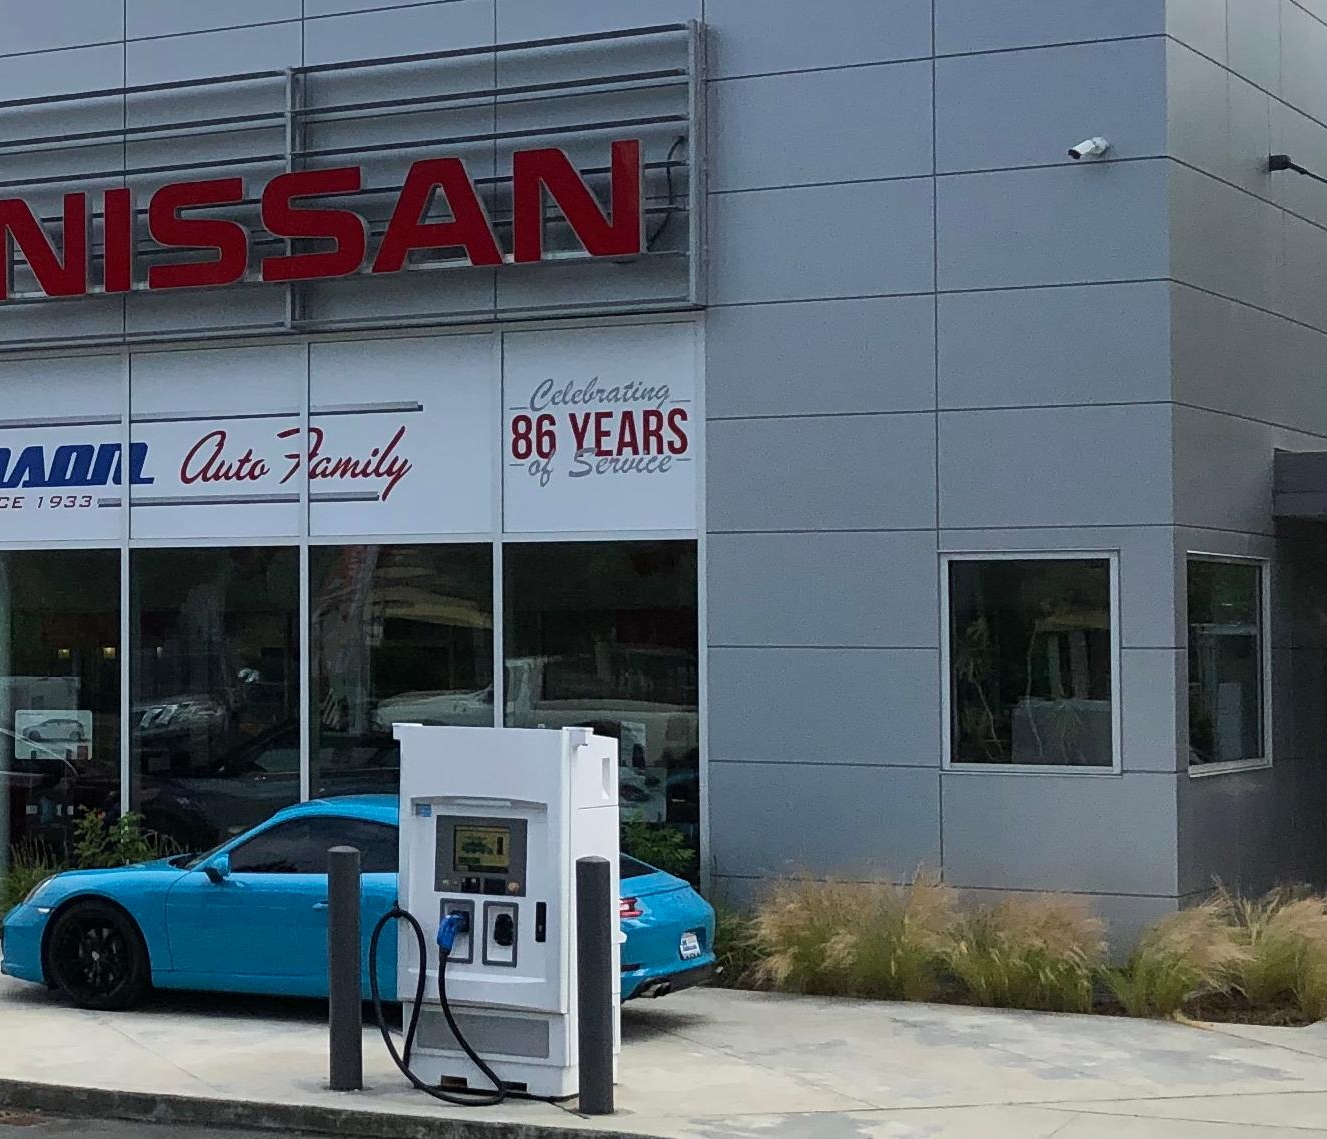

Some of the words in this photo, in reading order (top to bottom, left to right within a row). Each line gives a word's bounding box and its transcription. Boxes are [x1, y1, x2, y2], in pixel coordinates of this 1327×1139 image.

[529, 376, 671, 412] Celebrating
[511, 413, 557, 460] 86
[568, 407, 689, 457] YEARS
[180, 430, 271, 485] Auto
[276, 425, 413, 502] Family
[527, 448, 557, 487] of
[568, 447, 673, 478] Service
[37, 495, 93, 510] 1933
